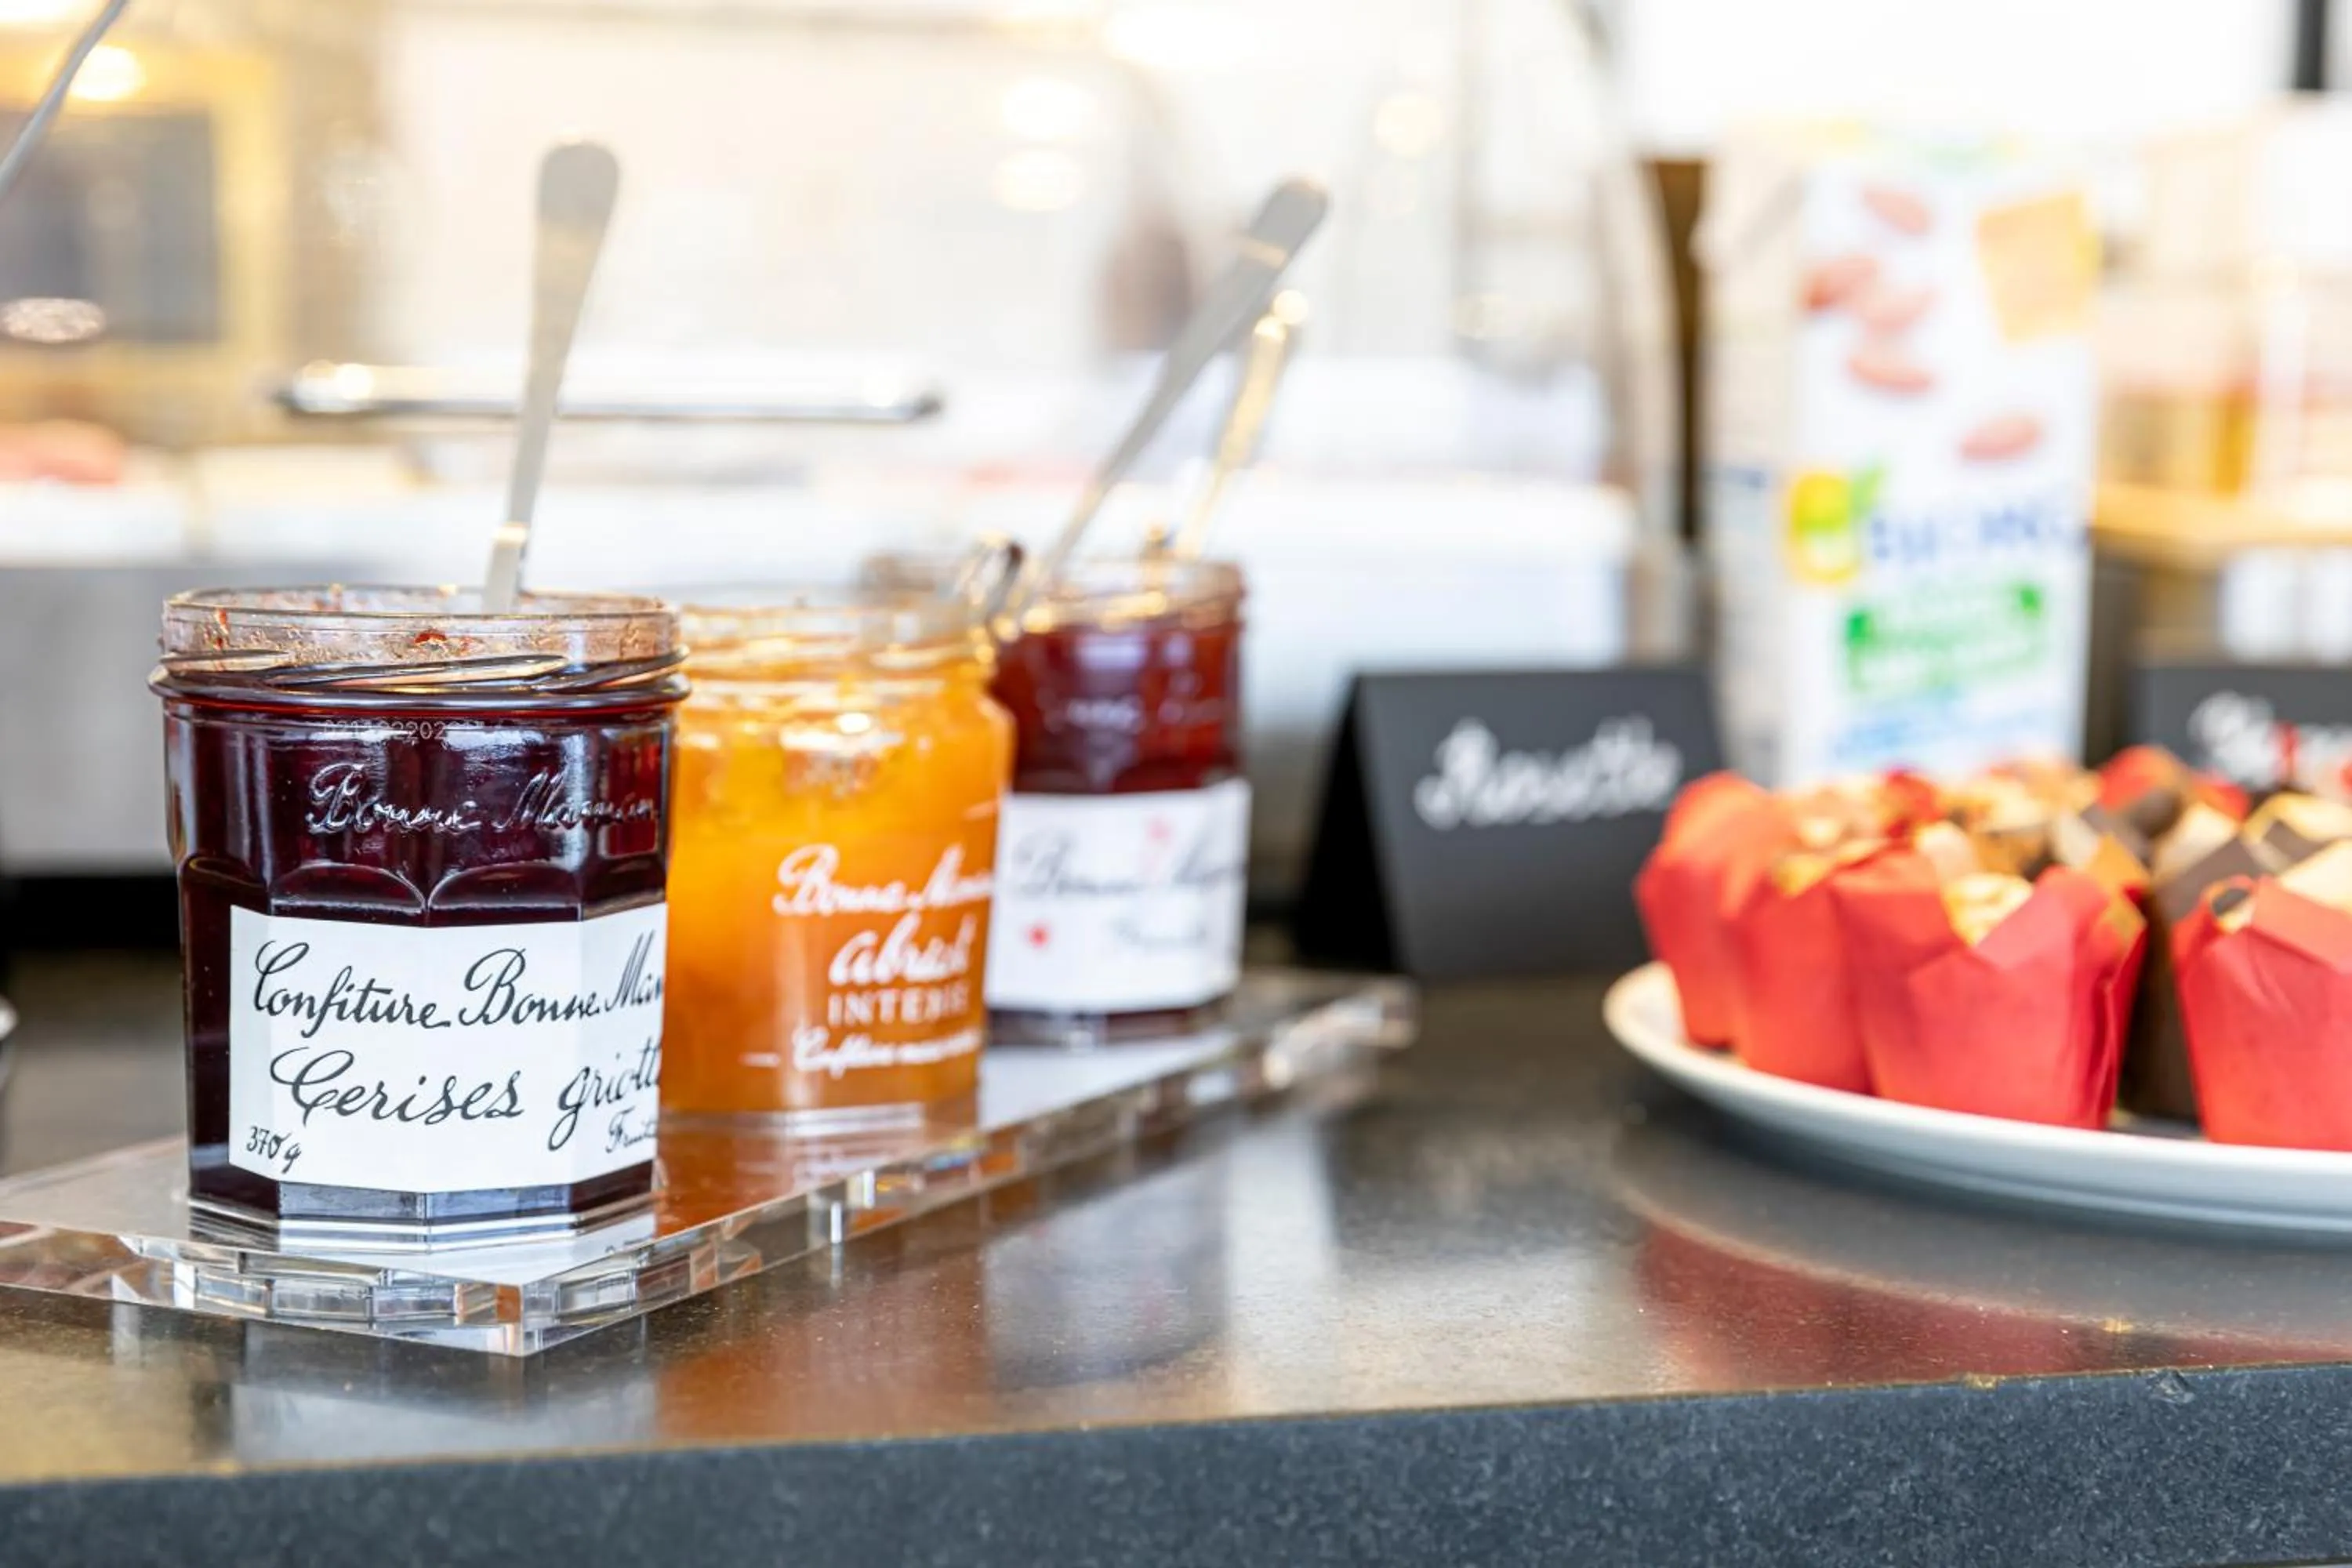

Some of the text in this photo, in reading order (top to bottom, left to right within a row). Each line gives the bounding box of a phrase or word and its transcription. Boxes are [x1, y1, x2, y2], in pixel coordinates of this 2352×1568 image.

[254, 940, 451, 1038] Confiture
[458, 948, 601, 1025] Bonne
[270, 1047, 524, 1127] Cerises
